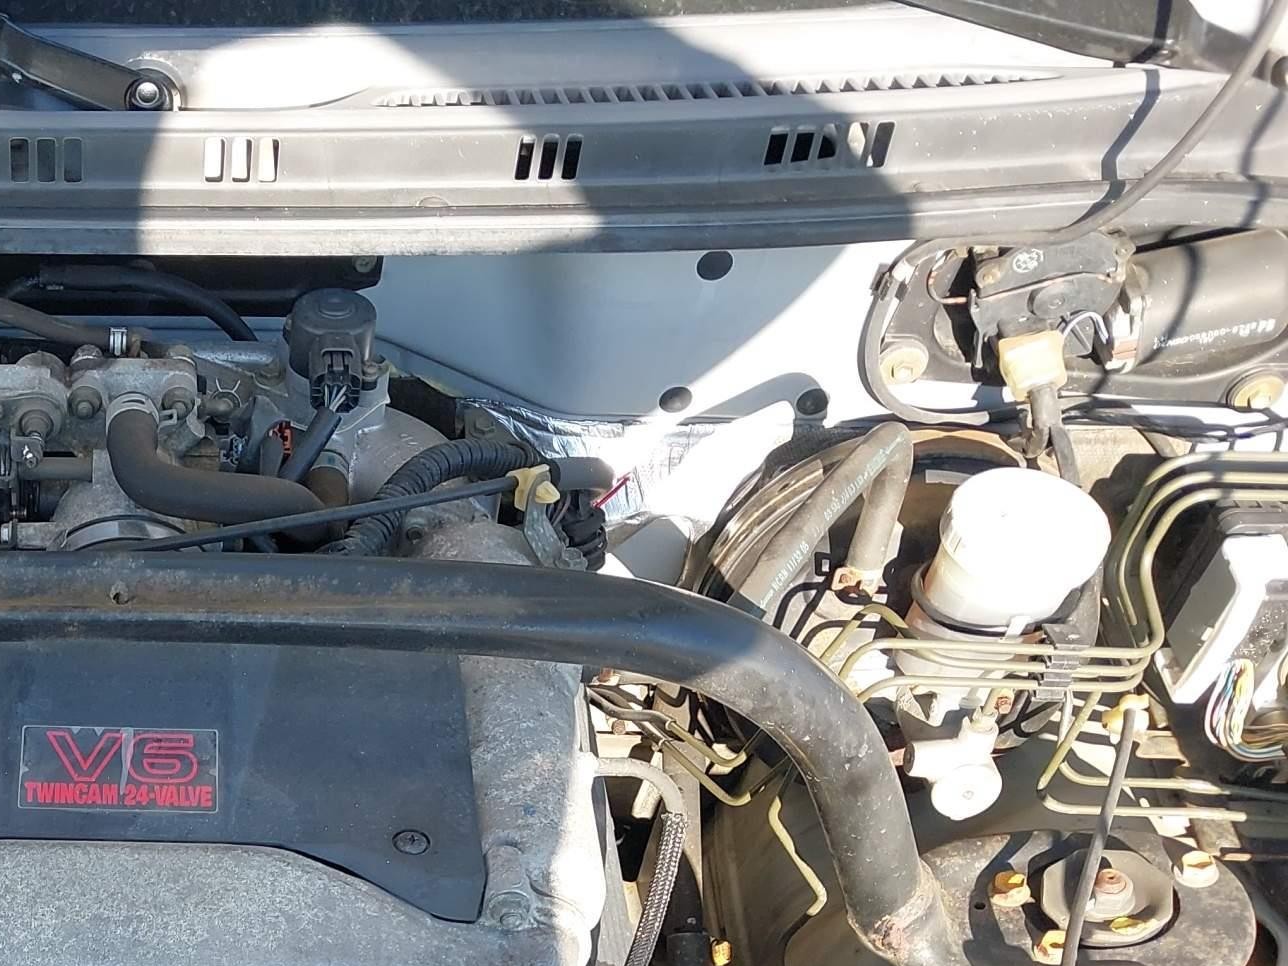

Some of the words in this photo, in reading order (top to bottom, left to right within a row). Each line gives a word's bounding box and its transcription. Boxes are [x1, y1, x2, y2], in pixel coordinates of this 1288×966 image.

[46, 730, 199, 783] V6
[24, 781, 119, 805] TWINCAM
[123, 783, 214, 808] 24-VALVE
